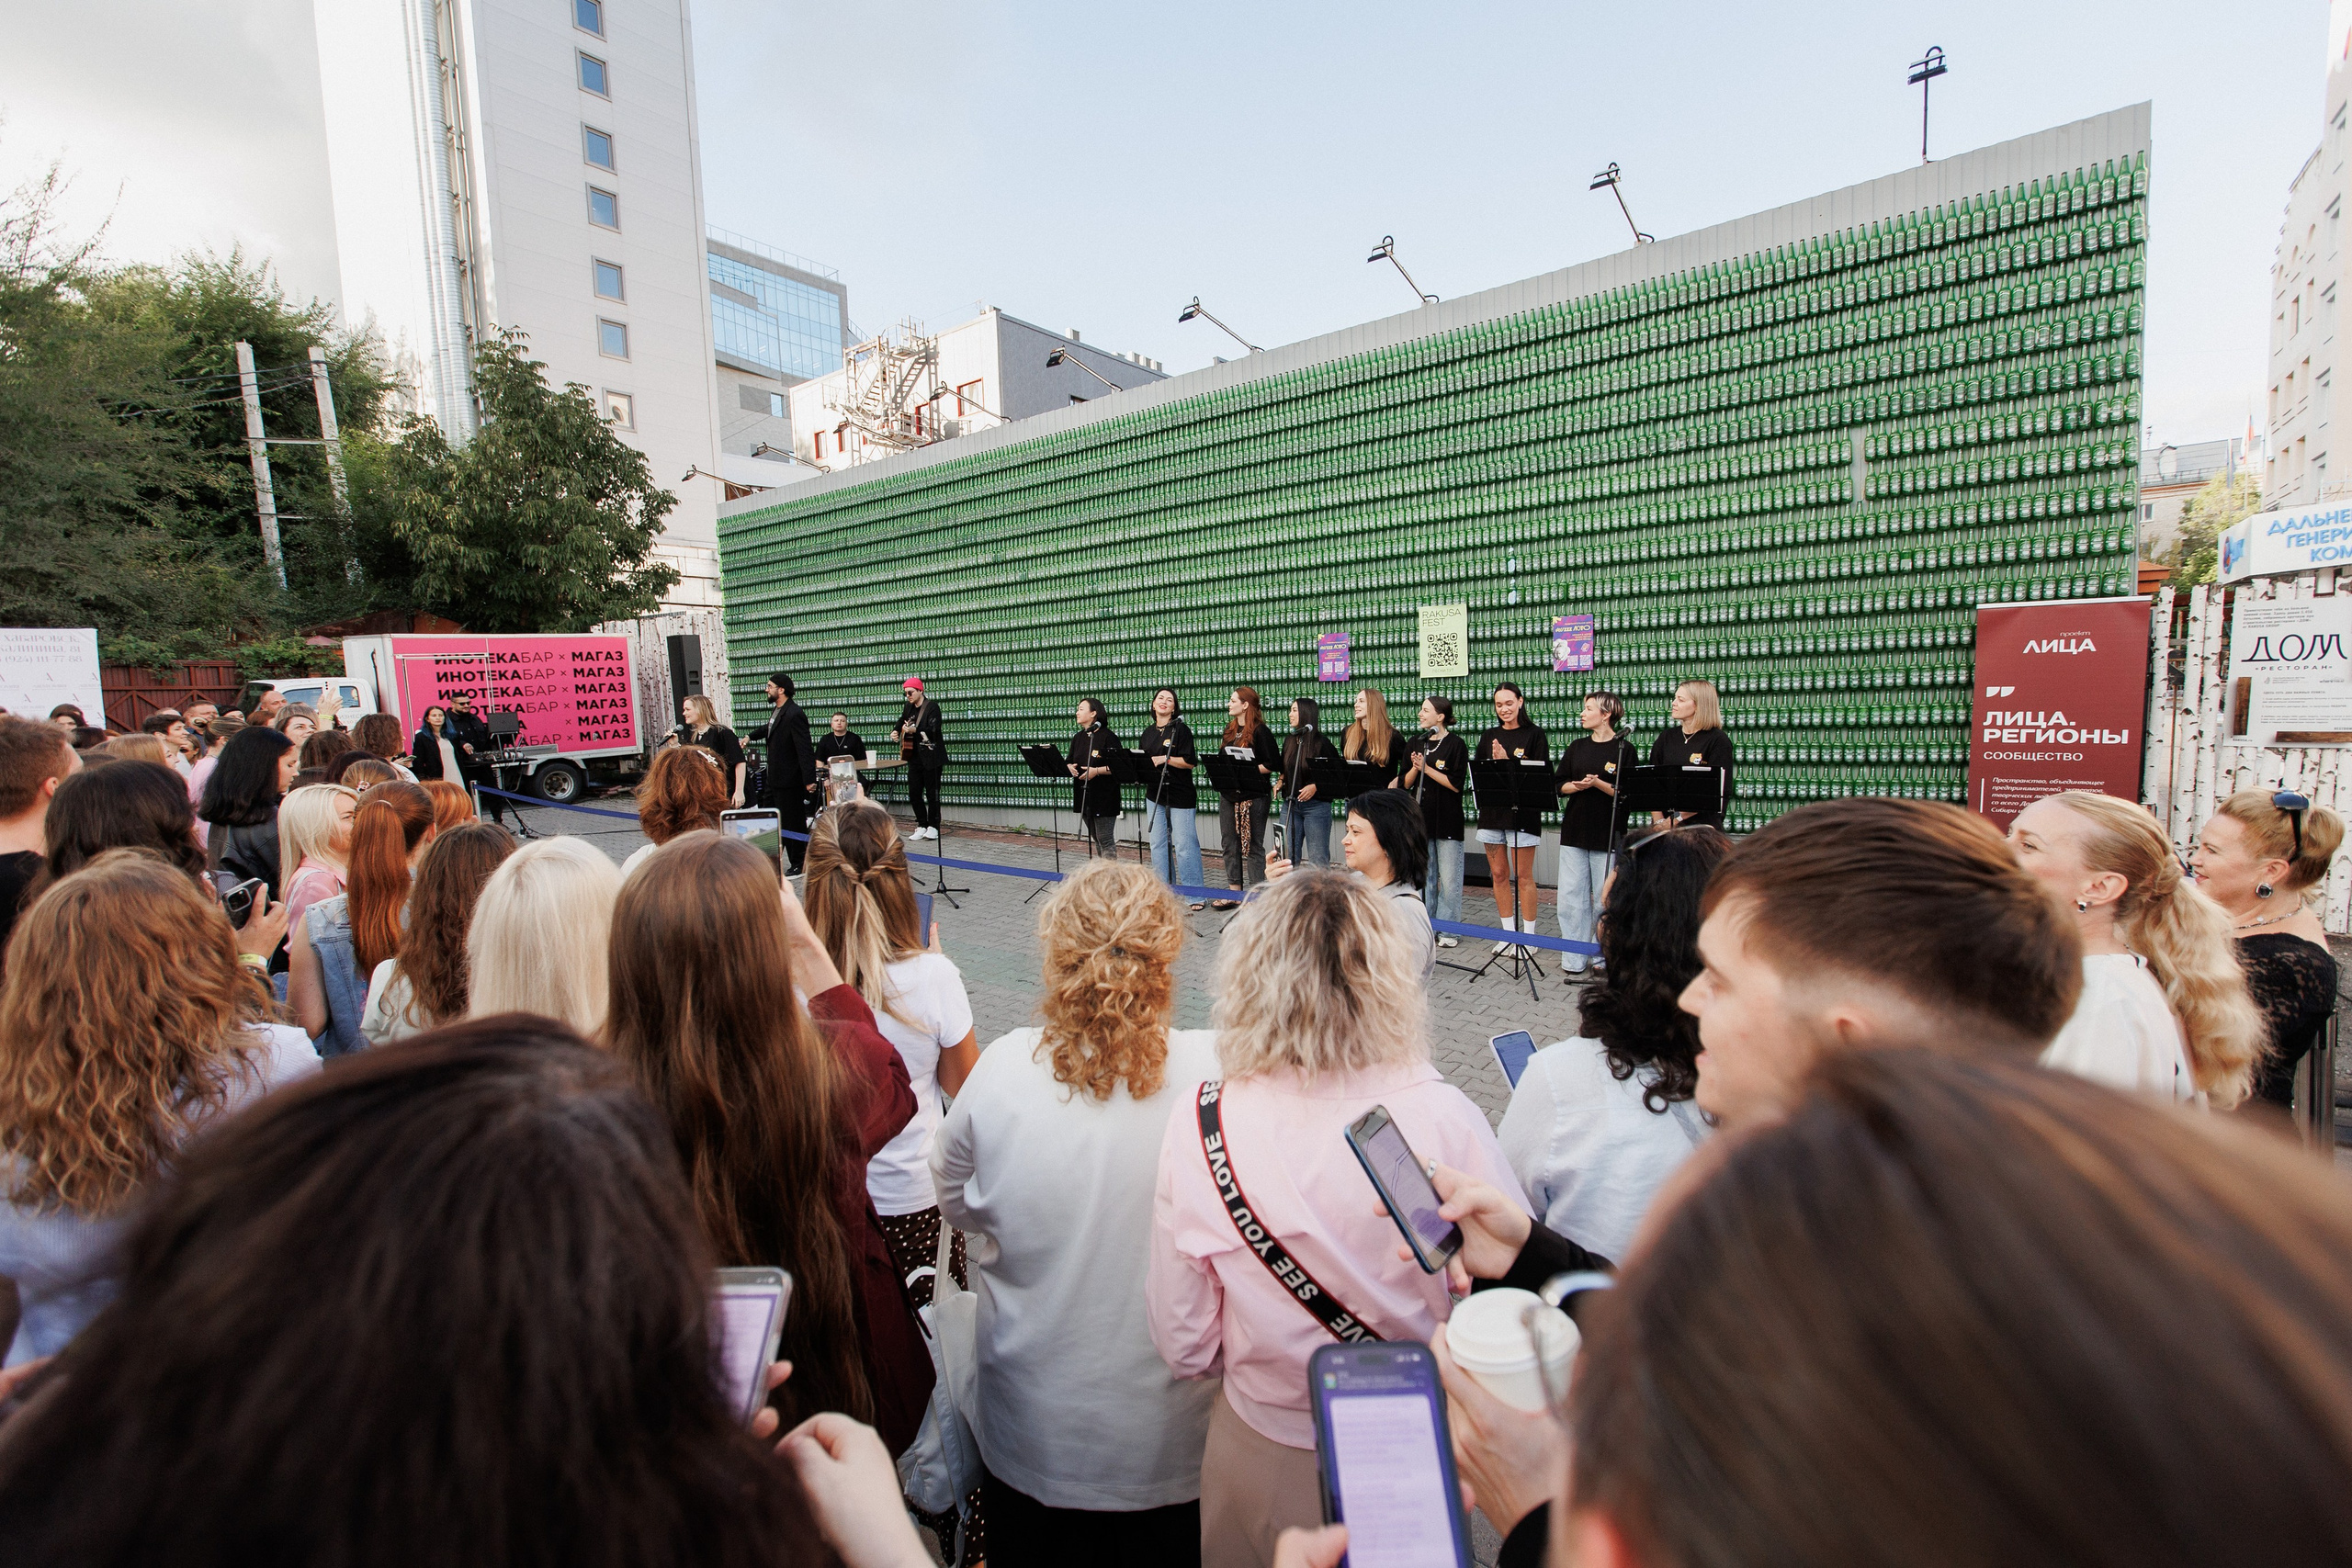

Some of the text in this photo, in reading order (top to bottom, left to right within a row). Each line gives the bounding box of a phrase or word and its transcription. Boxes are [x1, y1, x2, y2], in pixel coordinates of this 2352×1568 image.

[2267, 508, 2352, 536] ДАЛЬНЕ
[1422, 608, 1462, 618] RAKUSA
[1422, 618, 1445, 626] FEST
[2022, 637, 2097, 655] ЛИЦА
[2241, 634, 2347, 662] ДОМ
[571, 651, 624, 661] МАГАЗ
[573, 667, 625, 678] МАГАЗ
[574, 682, 626, 694] МАГАЗ
[576, 698, 628, 710] МАГАЗ
[578, 714, 628, 726] МАГАЗ
[1983, 711, 2076, 728] ЛИЦА.
[579, 728, 630, 741] МАГАЗ
[1983, 728, 2129, 744] РЕГИОНЫ
[1983, 751, 2084, 761] СООБЩЕСТВО
[2049, 778, 2105, 786] объединяющее
[1990, 807, 2017, 816] Сибири
[1204, 1131, 1319, 1301] SEE YOU LOVE
